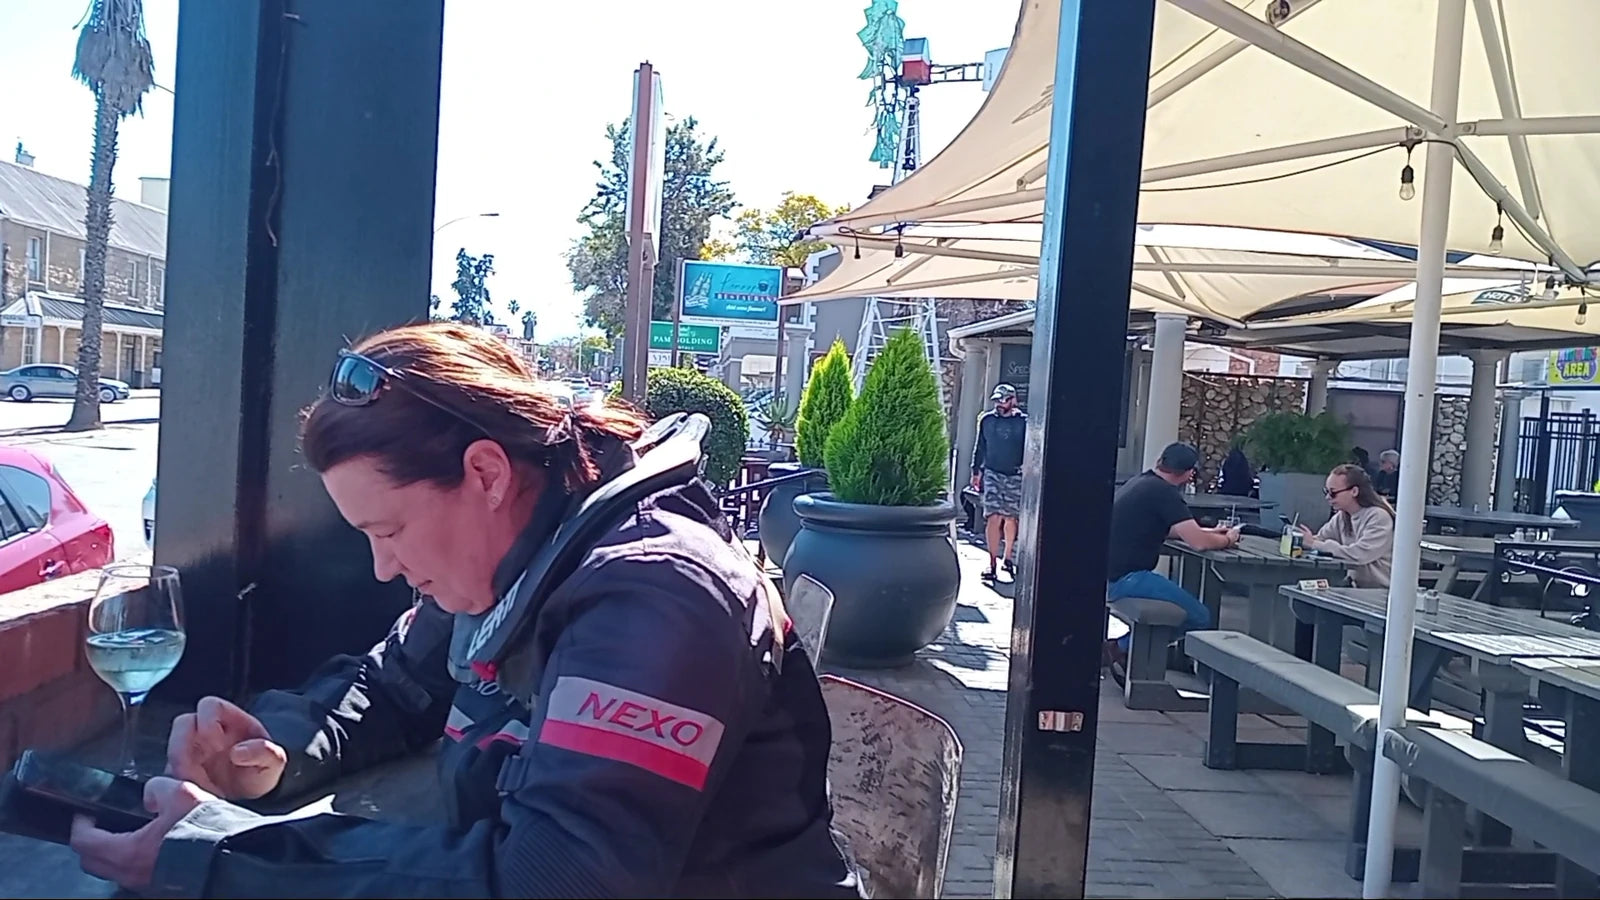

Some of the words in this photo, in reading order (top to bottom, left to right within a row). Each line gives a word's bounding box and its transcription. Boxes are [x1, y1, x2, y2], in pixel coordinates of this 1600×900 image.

[653, 335, 671, 343] PAM
[1563, 361, 1590, 377] AREA
[576, 692, 703, 747] NEXO
